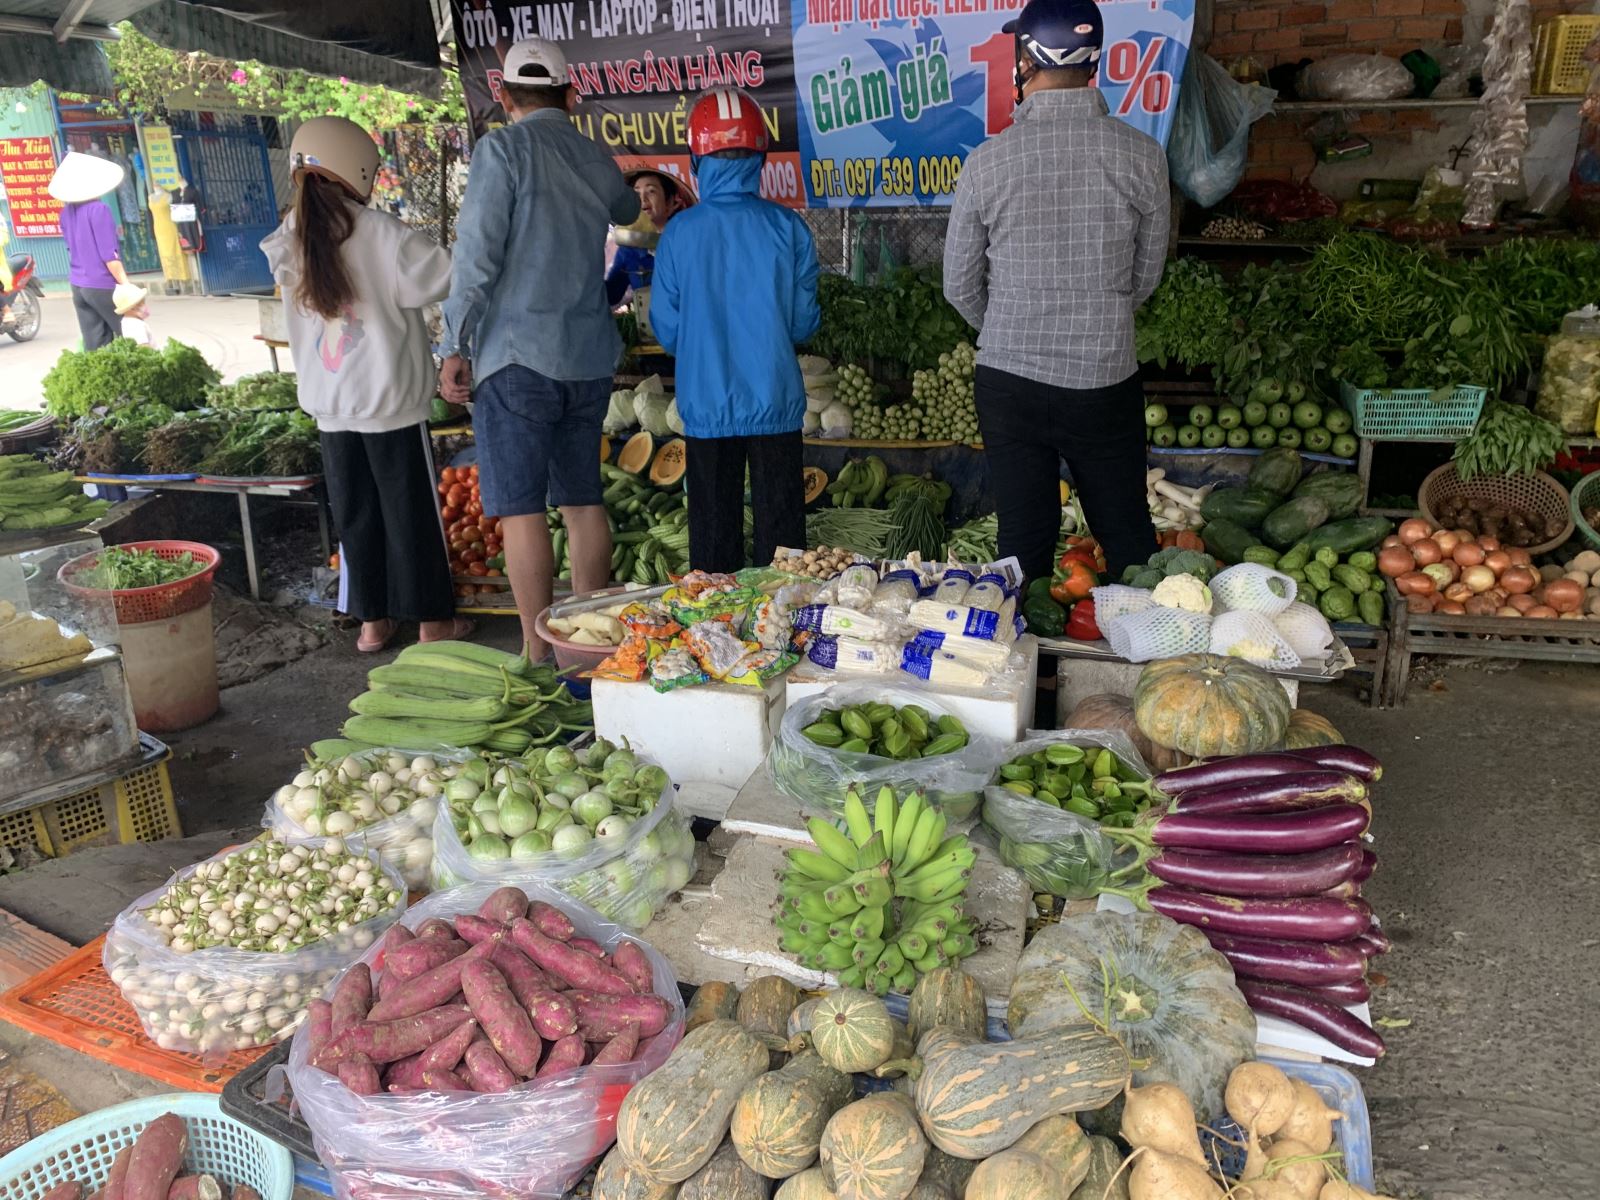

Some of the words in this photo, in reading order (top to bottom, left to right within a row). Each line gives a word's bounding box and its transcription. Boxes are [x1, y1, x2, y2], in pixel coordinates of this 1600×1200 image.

[463, 1, 498, 49] ÔTÔ
[509, 6, 533, 43] XE
[588, 0, 657, 38] LAPTOP
[605, 50, 681, 95] NGÂN
[686, 46, 764, 90] HÀNG
[810, 57, 893, 134] Giảm
[898, 37, 952, 122] giá
[602, 95, 687, 146] CHUYỂ
[844, 156, 876, 197] 097
[881, 156, 914, 196] 539
